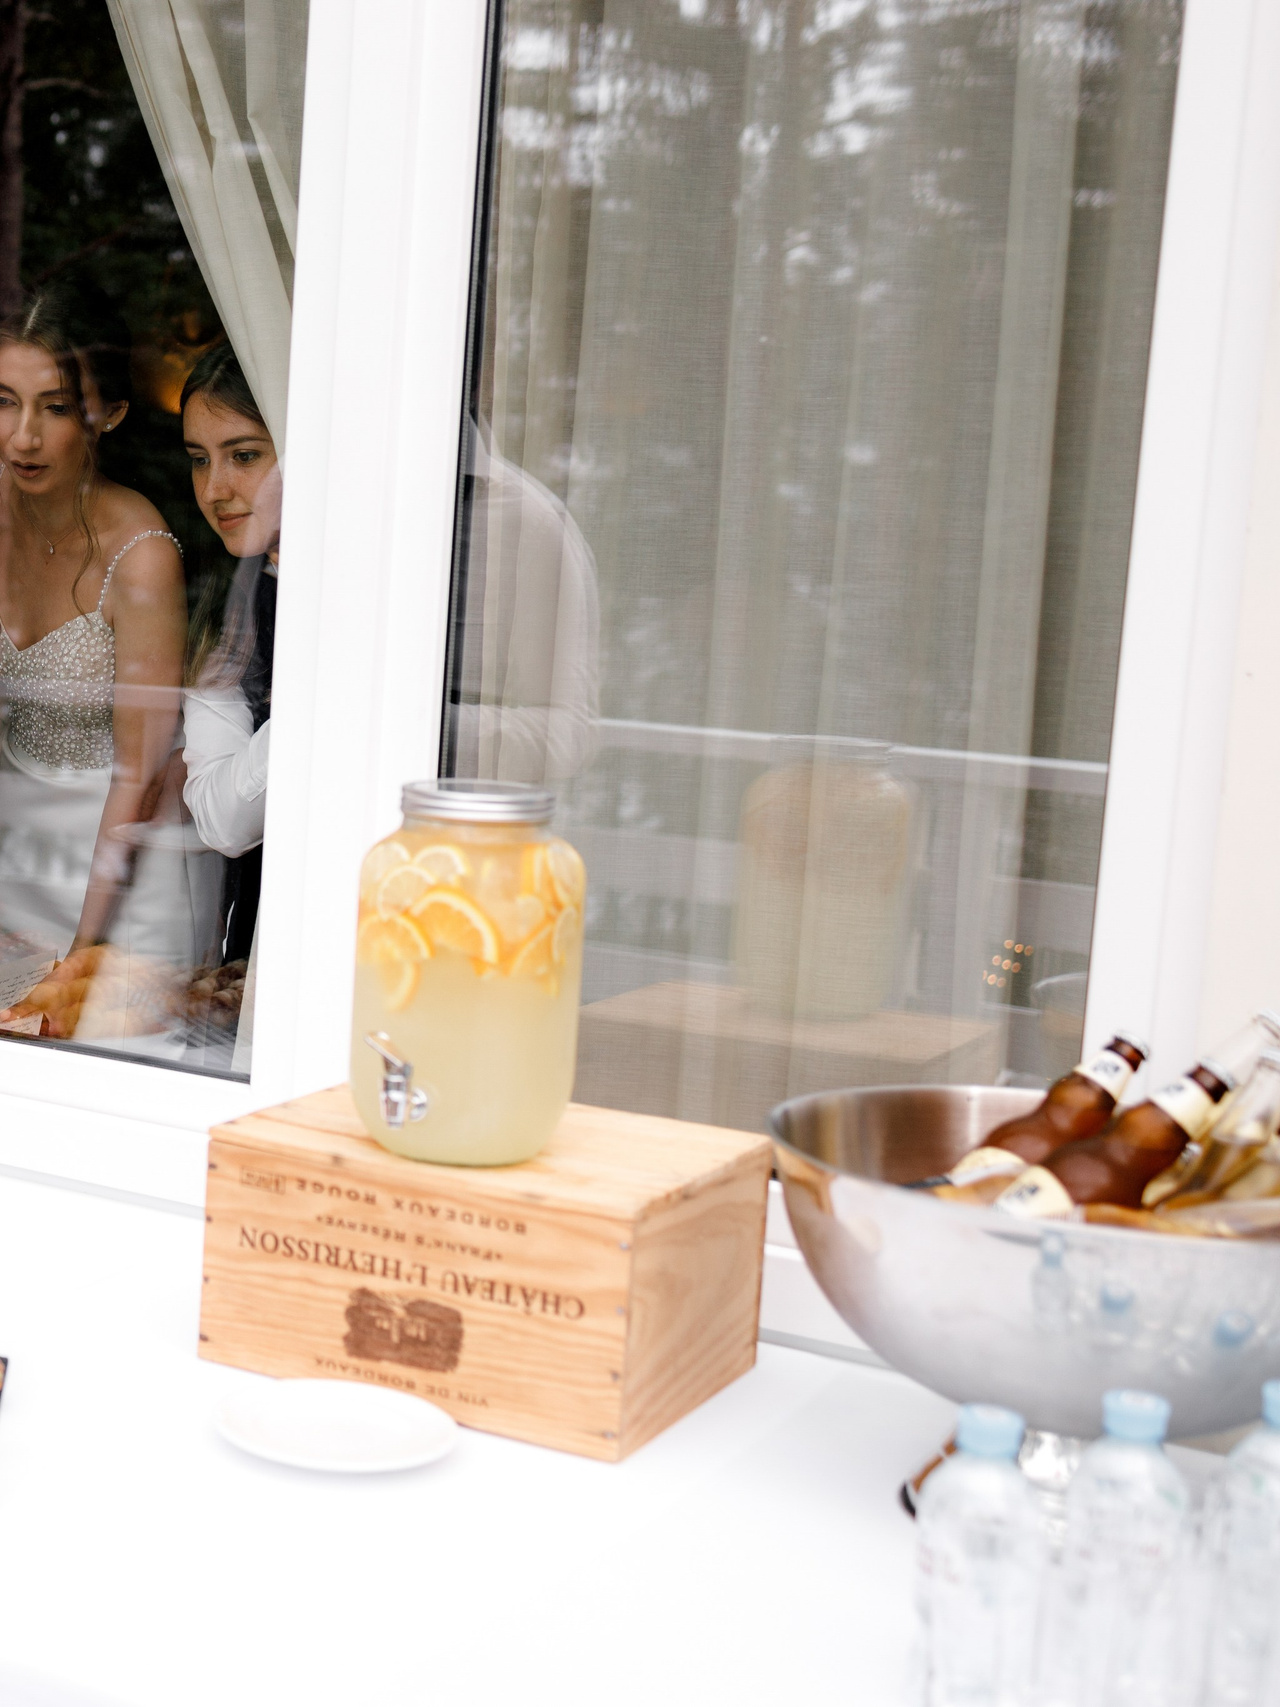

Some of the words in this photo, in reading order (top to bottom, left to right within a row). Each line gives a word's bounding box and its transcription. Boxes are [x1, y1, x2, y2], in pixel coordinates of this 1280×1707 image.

[296, 1178, 377, 1205] ROUGE
[393, 1199, 527, 1235] BORDEAUX
[239, 1226, 429, 1286] L'HEYRISSON
[440, 1270, 586, 1320] CHÂTEAU
[315, 1357, 415, 1389] BORDEAUX
[425, 1384, 450, 1399] DE
[458, 1391, 489, 1408] VIN
